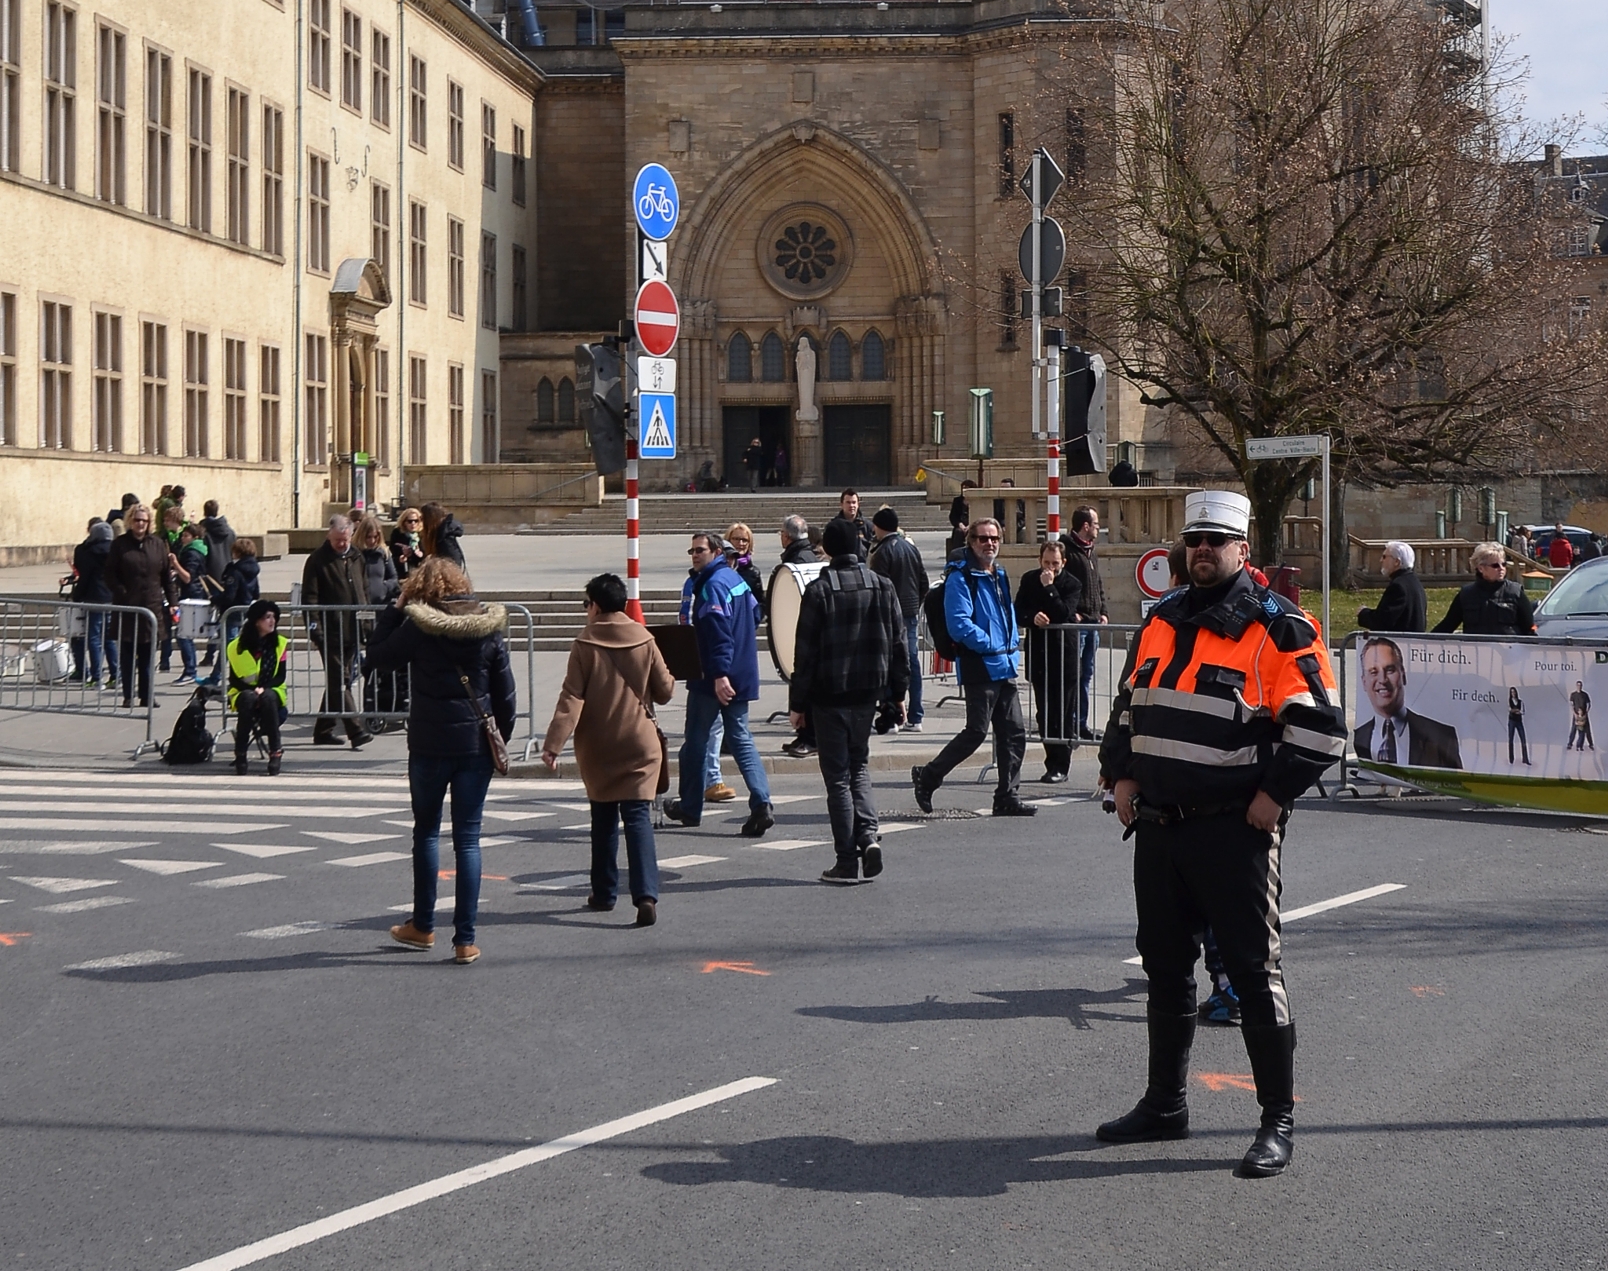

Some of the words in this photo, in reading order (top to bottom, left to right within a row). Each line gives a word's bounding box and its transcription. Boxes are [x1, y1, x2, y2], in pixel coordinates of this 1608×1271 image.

[1411, 648, 1434, 663] Für
[1438, 650, 1472, 664] dich.
[1535, 661, 1557, 671] Pour
[1561, 661, 1577, 671] toi.
[1452, 689, 1468, 701] Fir
[1471, 690, 1500, 704] dech.
